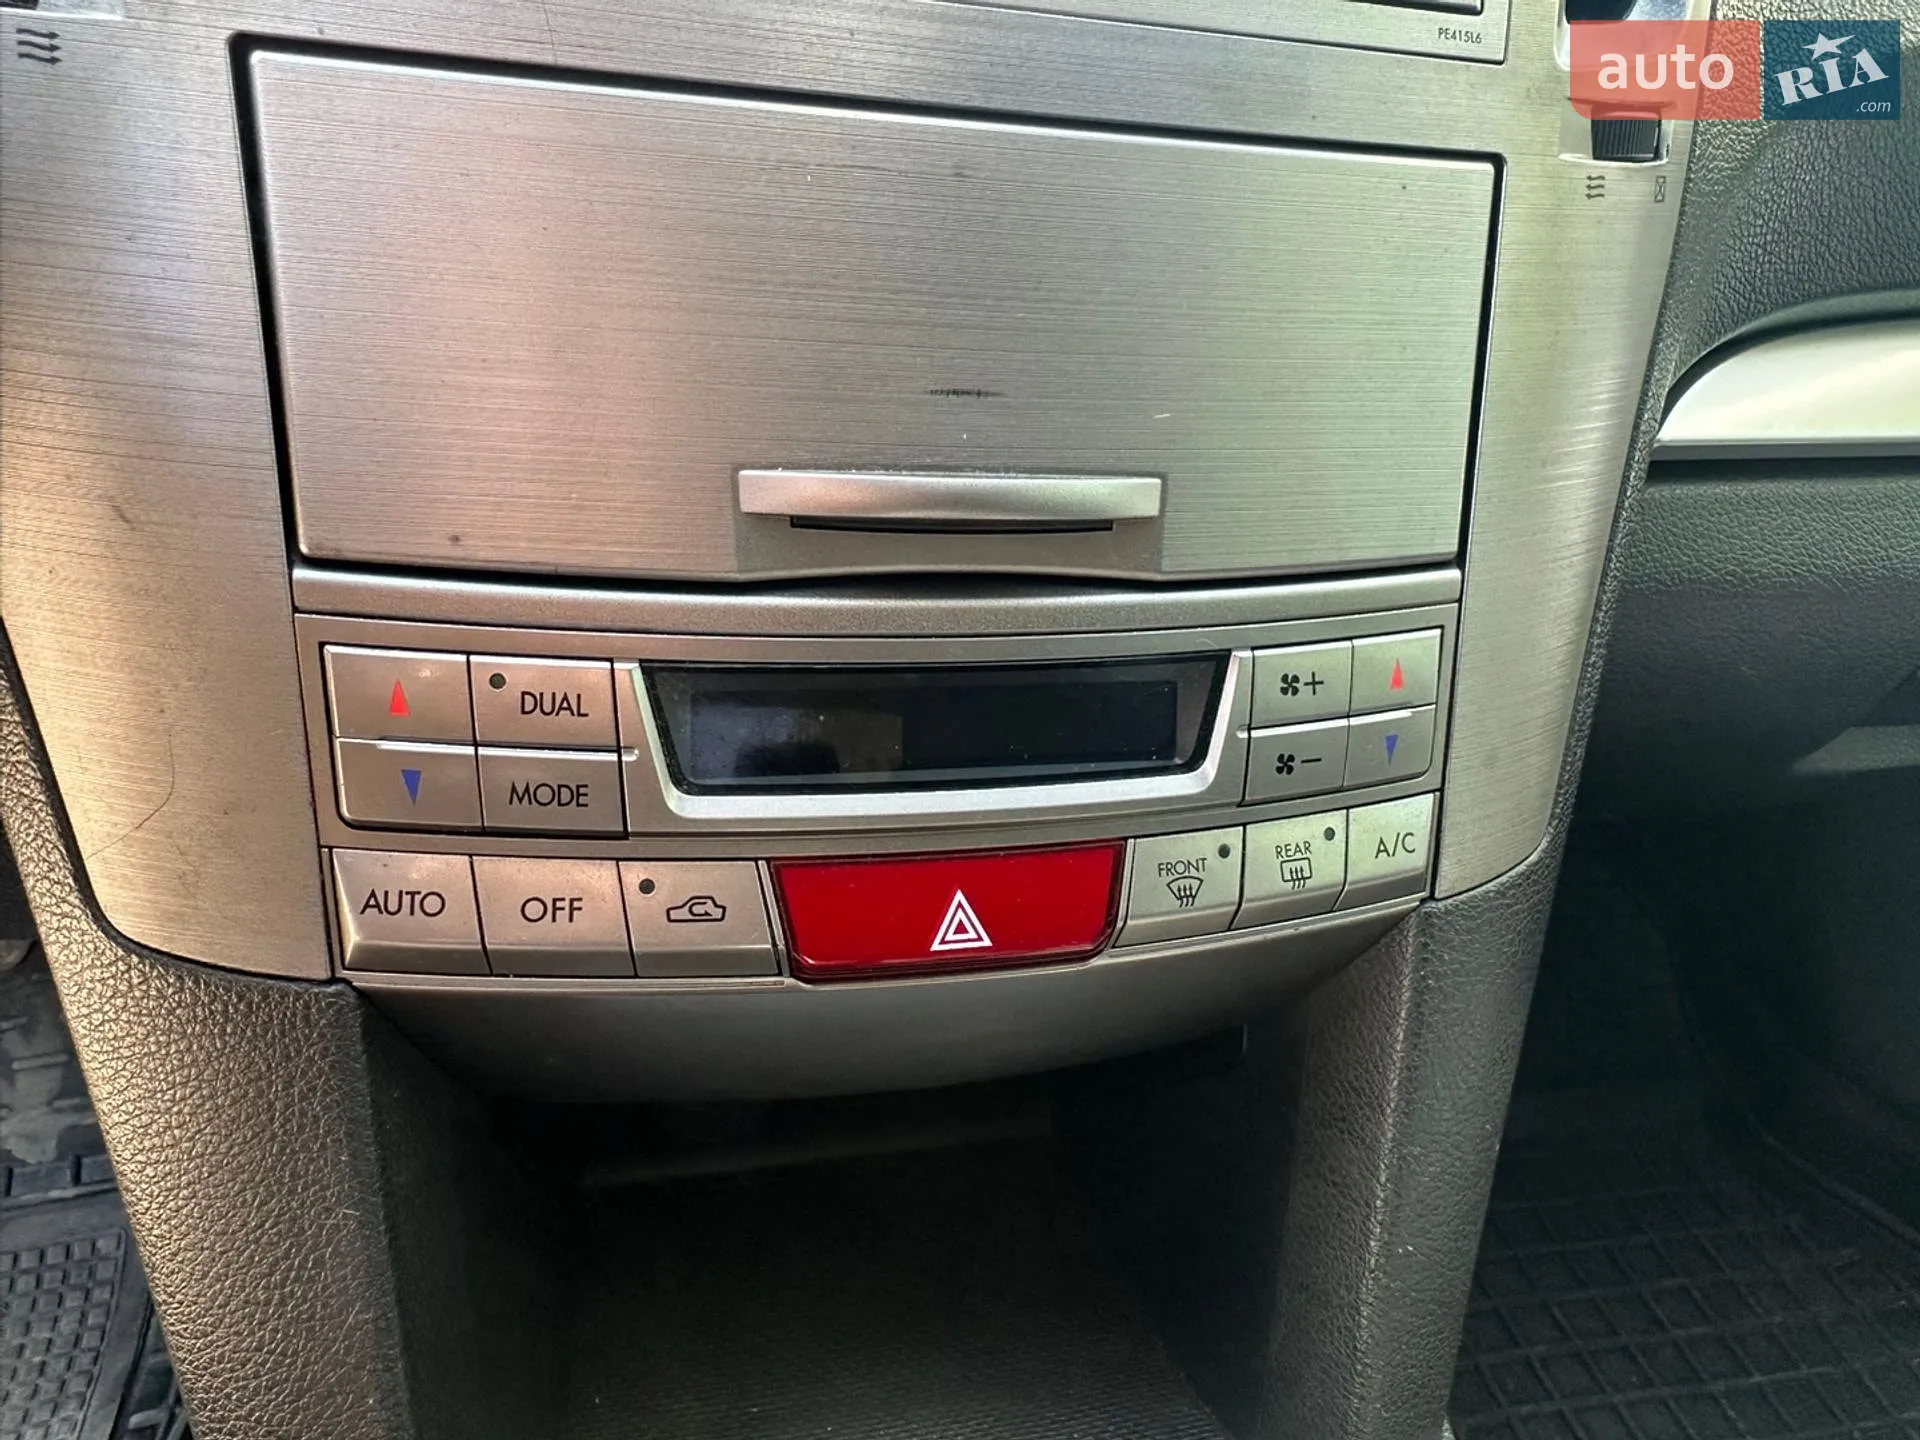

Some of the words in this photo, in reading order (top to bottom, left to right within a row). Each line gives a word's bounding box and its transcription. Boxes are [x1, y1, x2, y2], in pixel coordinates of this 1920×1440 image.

[520, 691, 589, 718] DUAL
[508, 782, 589, 808] MODE
[1274, 840, 1312, 860] REAR
[1374, 832, 1416, 860] A/C
[1157, 857, 1207, 878] FRONT
[360, 888, 446, 918] AUTO
[520, 896, 583, 924] OFF
